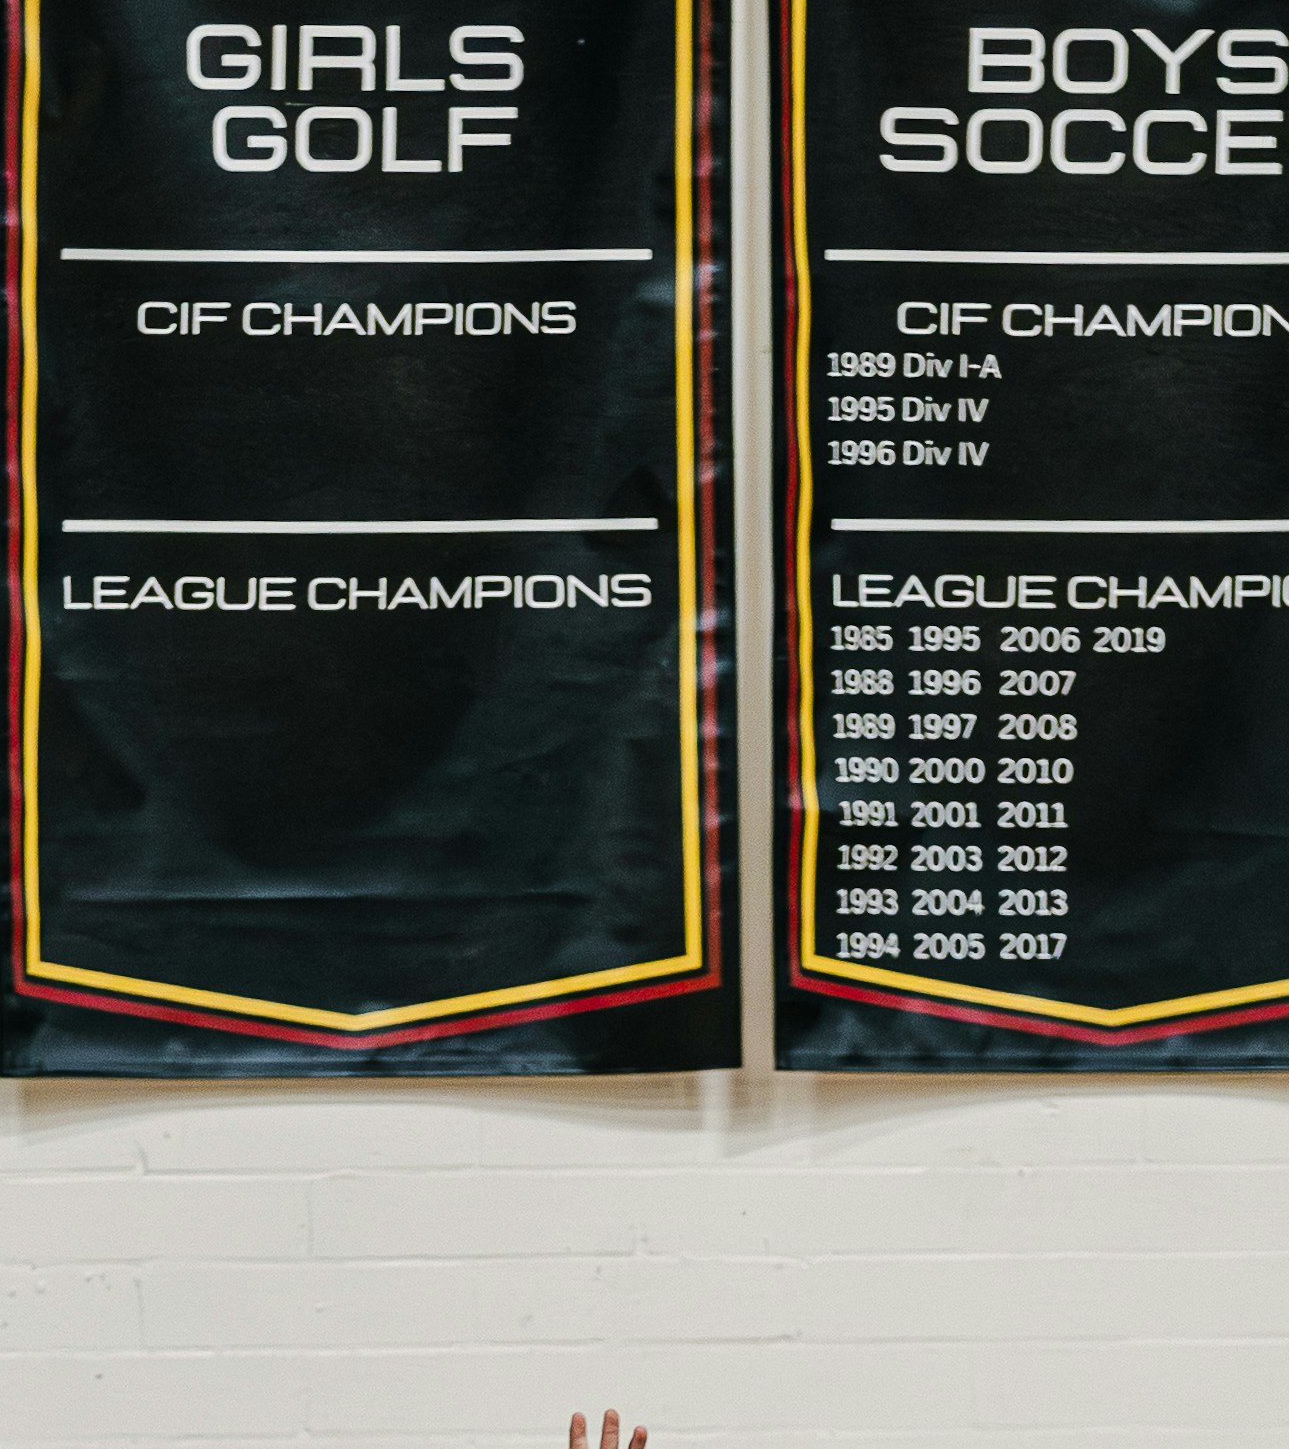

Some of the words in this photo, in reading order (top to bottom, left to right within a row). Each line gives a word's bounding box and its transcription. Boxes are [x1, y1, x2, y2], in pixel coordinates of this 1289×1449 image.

[185, 23, 525, 92] GIRLS
[967, 27, 1289, 95] BOYS
[212, 105, 519, 173] GOLF
[137, 301, 232, 336] CIF
[242, 300, 577, 336] CHAMPIONS
[896, 301, 992, 336] CIF
[826, 351, 897, 378] 1989
[902, 351, 954, 379] Div
[959, 353, 1003, 380] I-A
[827, 395, 896, 422] 1995
[901, 395, 952, 423] Div
[957, 397, 990, 423] IV
[827, 439, 897, 466] 1996
[902, 439, 953, 466] Div
[958, 441, 990, 467] IV
[62, 575, 297, 611] LEAGUE
[307, 573, 652, 611] CHAMPIONS
[832, 573, 1058, 610] LEAGUE
[829, 624, 894, 652] 1985
[908, 625, 981, 652] 1995
[999, 625, 1082, 654] 2006
[1092, 626, 1166, 654] 2019
[830, 668, 895, 696] 1988
[907, 669, 982, 696] 1996
[998, 669, 1077, 697] 2007
[832, 712, 896, 740] 1989
[907, 712, 978, 741] 1997
[997, 713, 1078, 741] 2008
[834, 756, 900, 784] 1990
[908, 757, 986, 784] 2000
[996, 757, 1075, 785] 2010
[837, 799, 899, 828] 1991
[910, 800, 982, 829] 2001
[996, 800, 1069, 829] 2011
[836, 843, 899, 871] 1992
[910, 844, 984, 872] 2003
[997, 844, 1068, 873] 2012
[836, 887, 899, 916] 1993
[911, 888, 986, 917] 2004
[998, 888, 1069, 917] 2013
[836, 931, 901, 960] 1994
[912, 932, 986, 960] 2005
[999, 932, 1068, 960] 2017
